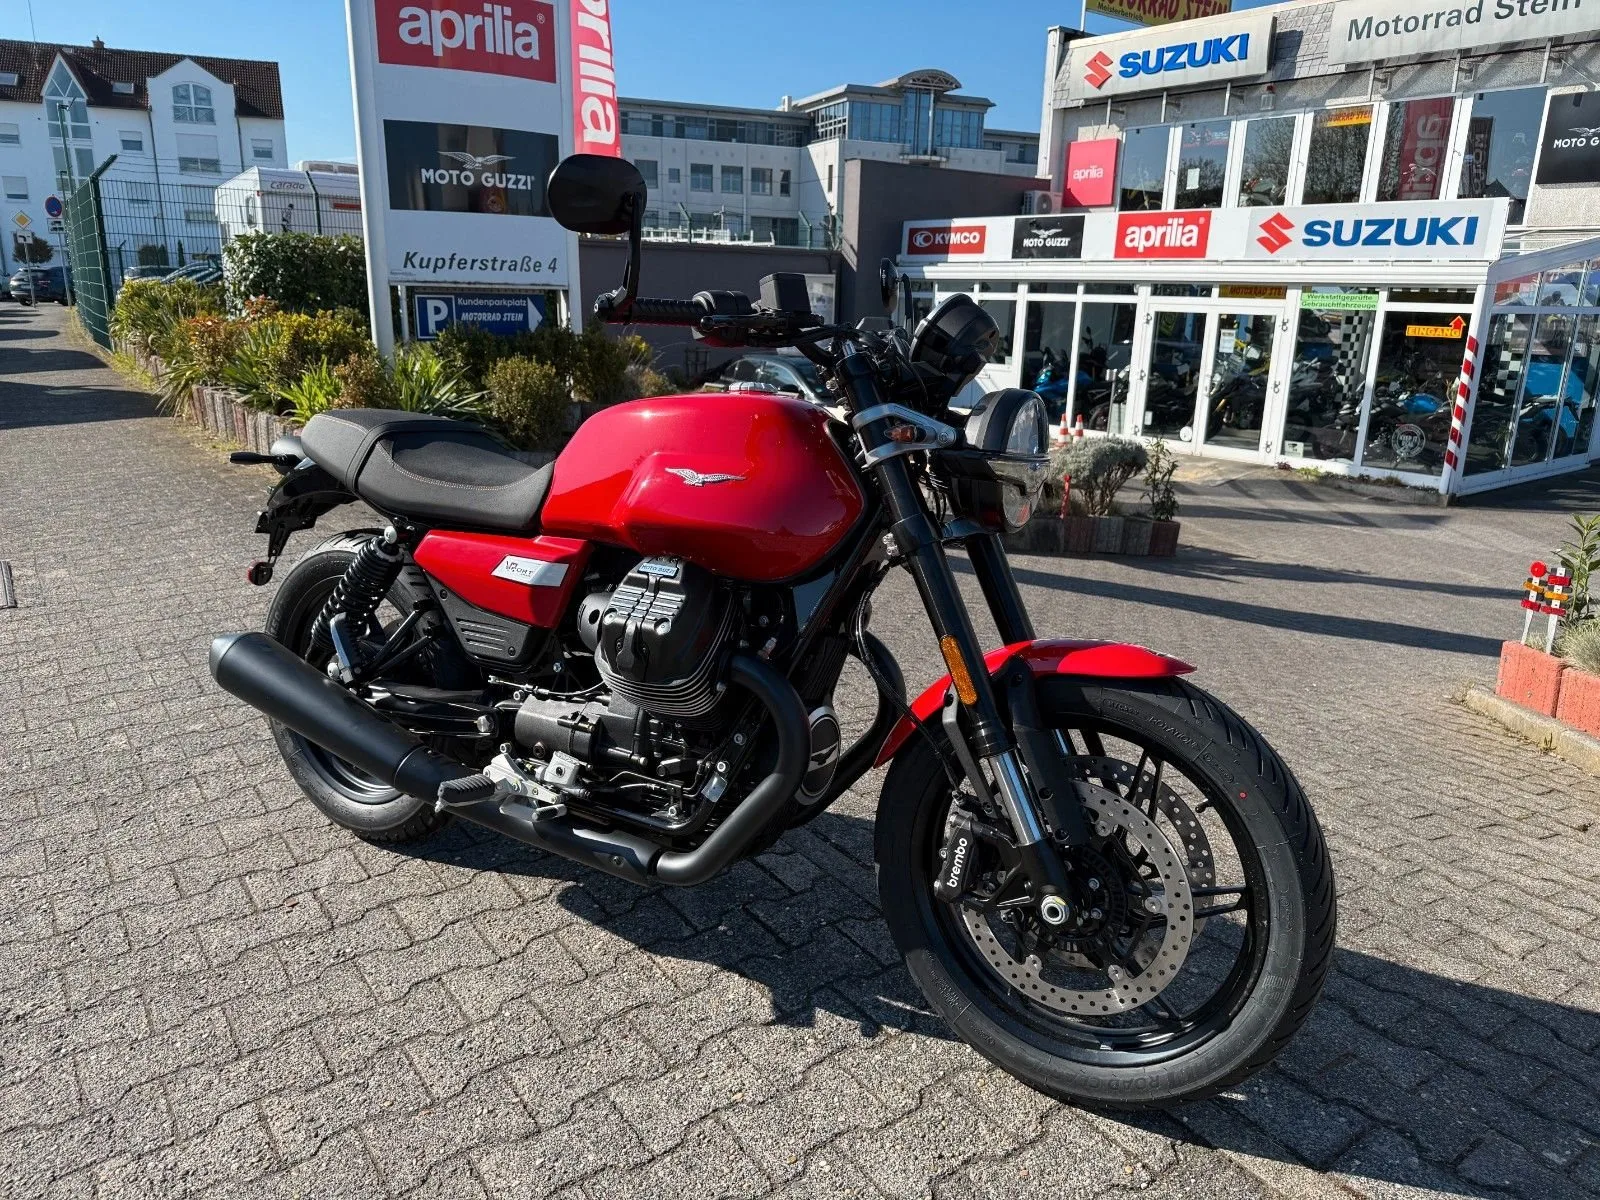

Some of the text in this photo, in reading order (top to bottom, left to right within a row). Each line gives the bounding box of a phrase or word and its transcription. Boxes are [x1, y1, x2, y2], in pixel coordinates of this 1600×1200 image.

[1097, 2, 1144, 22] Meisterbetrieb
[1347, 0, 1483, 41] Motorrad
[398, 3, 541, 61] aprilia
[1118, 33, 1250, 79] SUZUKI
[1553, 138, 1587, 149] MOTO
[420, 168, 533, 190] MOTO GUZZI
[1073, 165, 1104, 182] aprilia
[270, 180, 305, 190] carado
[934, 232, 981, 245] KYMCO
[1124, 217, 1199, 253] aprilia
[1302, 216, 1479, 247] SUZUKI
[1023, 237, 1070, 247] MOTO GUZZI
[402, 251, 558, 274] Kupferstraße 4
[457, 297, 527, 308] Kundenparkplatz
[1301, 301, 1377, 309] Gebrauchtfahrzeuge
[426, 299, 449, 335] P
[460, 312, 524, 322] MOTORRAD STEIN
[1407, 327, 1460, 337] EINGANG
[946, 837, 968, 888] brembo
